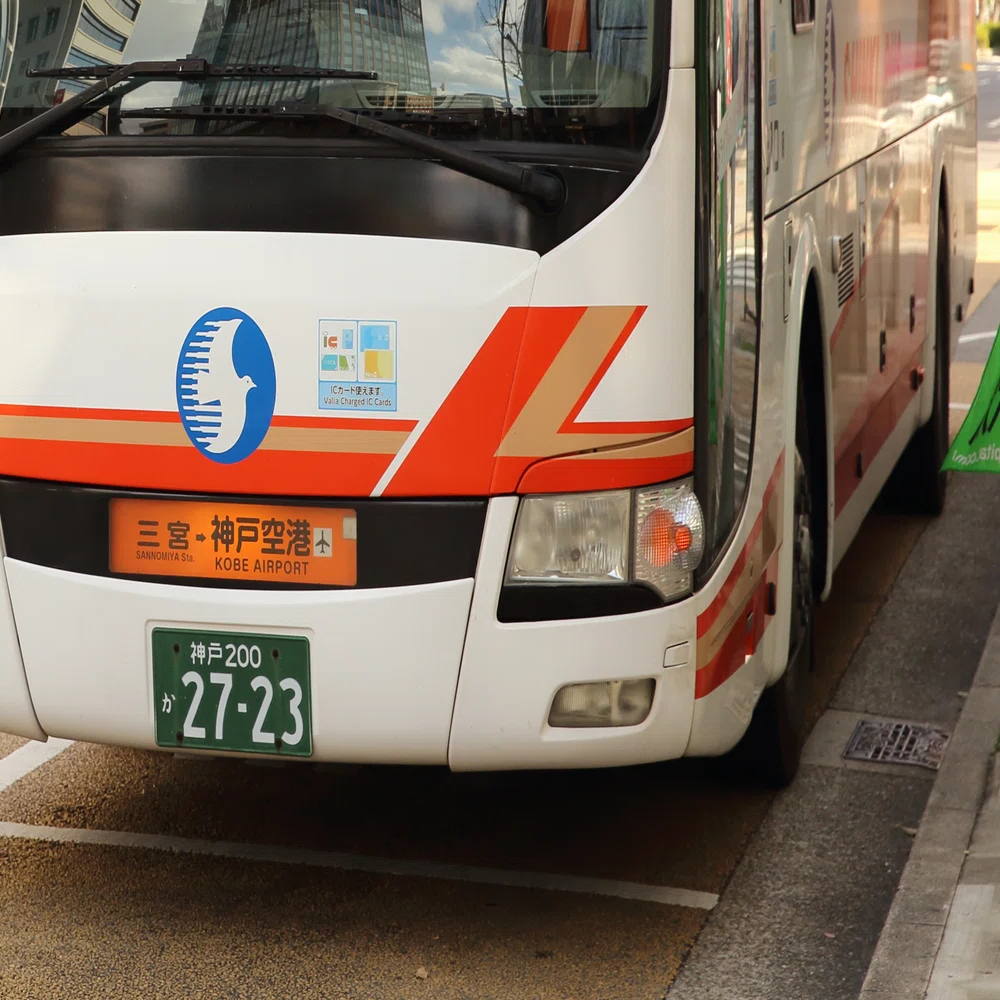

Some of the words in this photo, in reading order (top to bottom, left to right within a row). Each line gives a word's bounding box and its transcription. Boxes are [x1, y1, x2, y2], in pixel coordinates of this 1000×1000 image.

[340, 397, 365, 407] Charged
[366, 398, 373, 406] IC
[374, 398, 392, 406] Cards
[137, 520, 190, 550] 三宮
[211, 514, 311, 557] 神戸空港
[136, 550, 180, 562] SANNOMIYA
[181, 552, 195, 563] Sta.
[215, 557, 249, 572] KOBE
[253, 559, 309, 576] AIRPORT
[190, 641, 262, 669] 神戸200
[162, 692, 176, 713] か
[181, 671, 304, 746] 27-23
